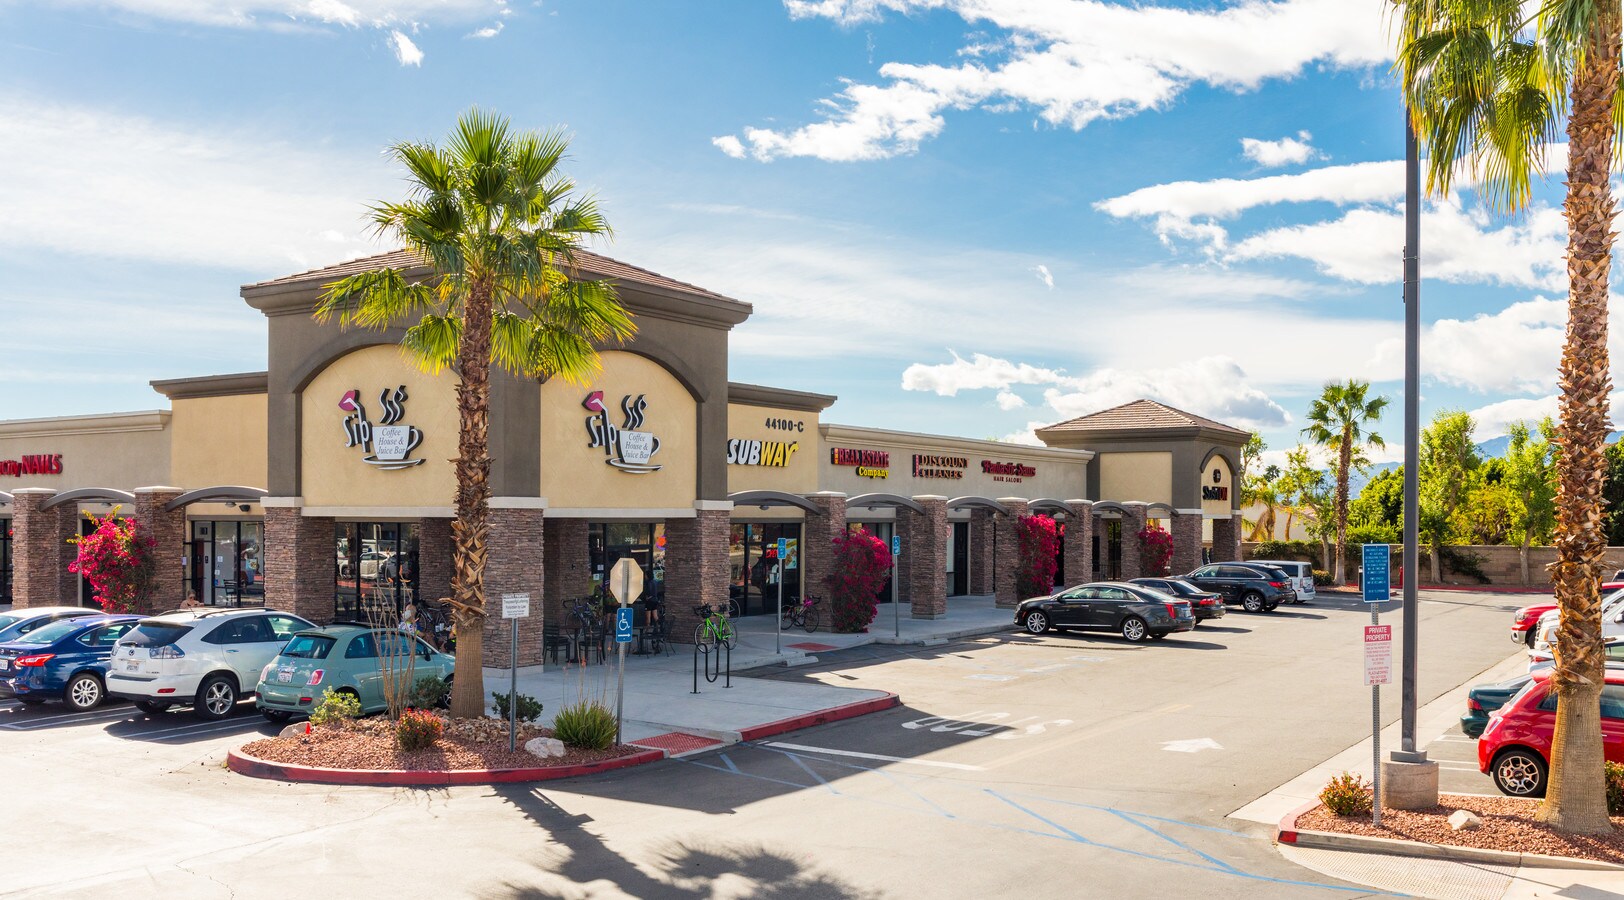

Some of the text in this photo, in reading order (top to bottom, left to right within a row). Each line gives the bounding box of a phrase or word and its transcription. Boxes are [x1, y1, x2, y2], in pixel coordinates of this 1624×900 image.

[765, 417, 804, 433] 44100-C
[381, 428, 402, 438] Coffee
[628, 433, 647, 442] Coffee
[378, 437, 398, 446] House
[625, 441, 642, 451] House
[376, 445, 406, 455] Juice Bar
[639, 450, 650, 459] Bar
[727, 438, 799, 467] SUBWAY
[22, 453, 63, 474] NAILS
[839, 447, 861, 466] REAL
[861, 449, 889, 468] ESTATE
[920, 454, 970, 468] DISCOUNT
[857, 466, 889, 479] Company
[920, 468, 963, 480] CLEANERS
